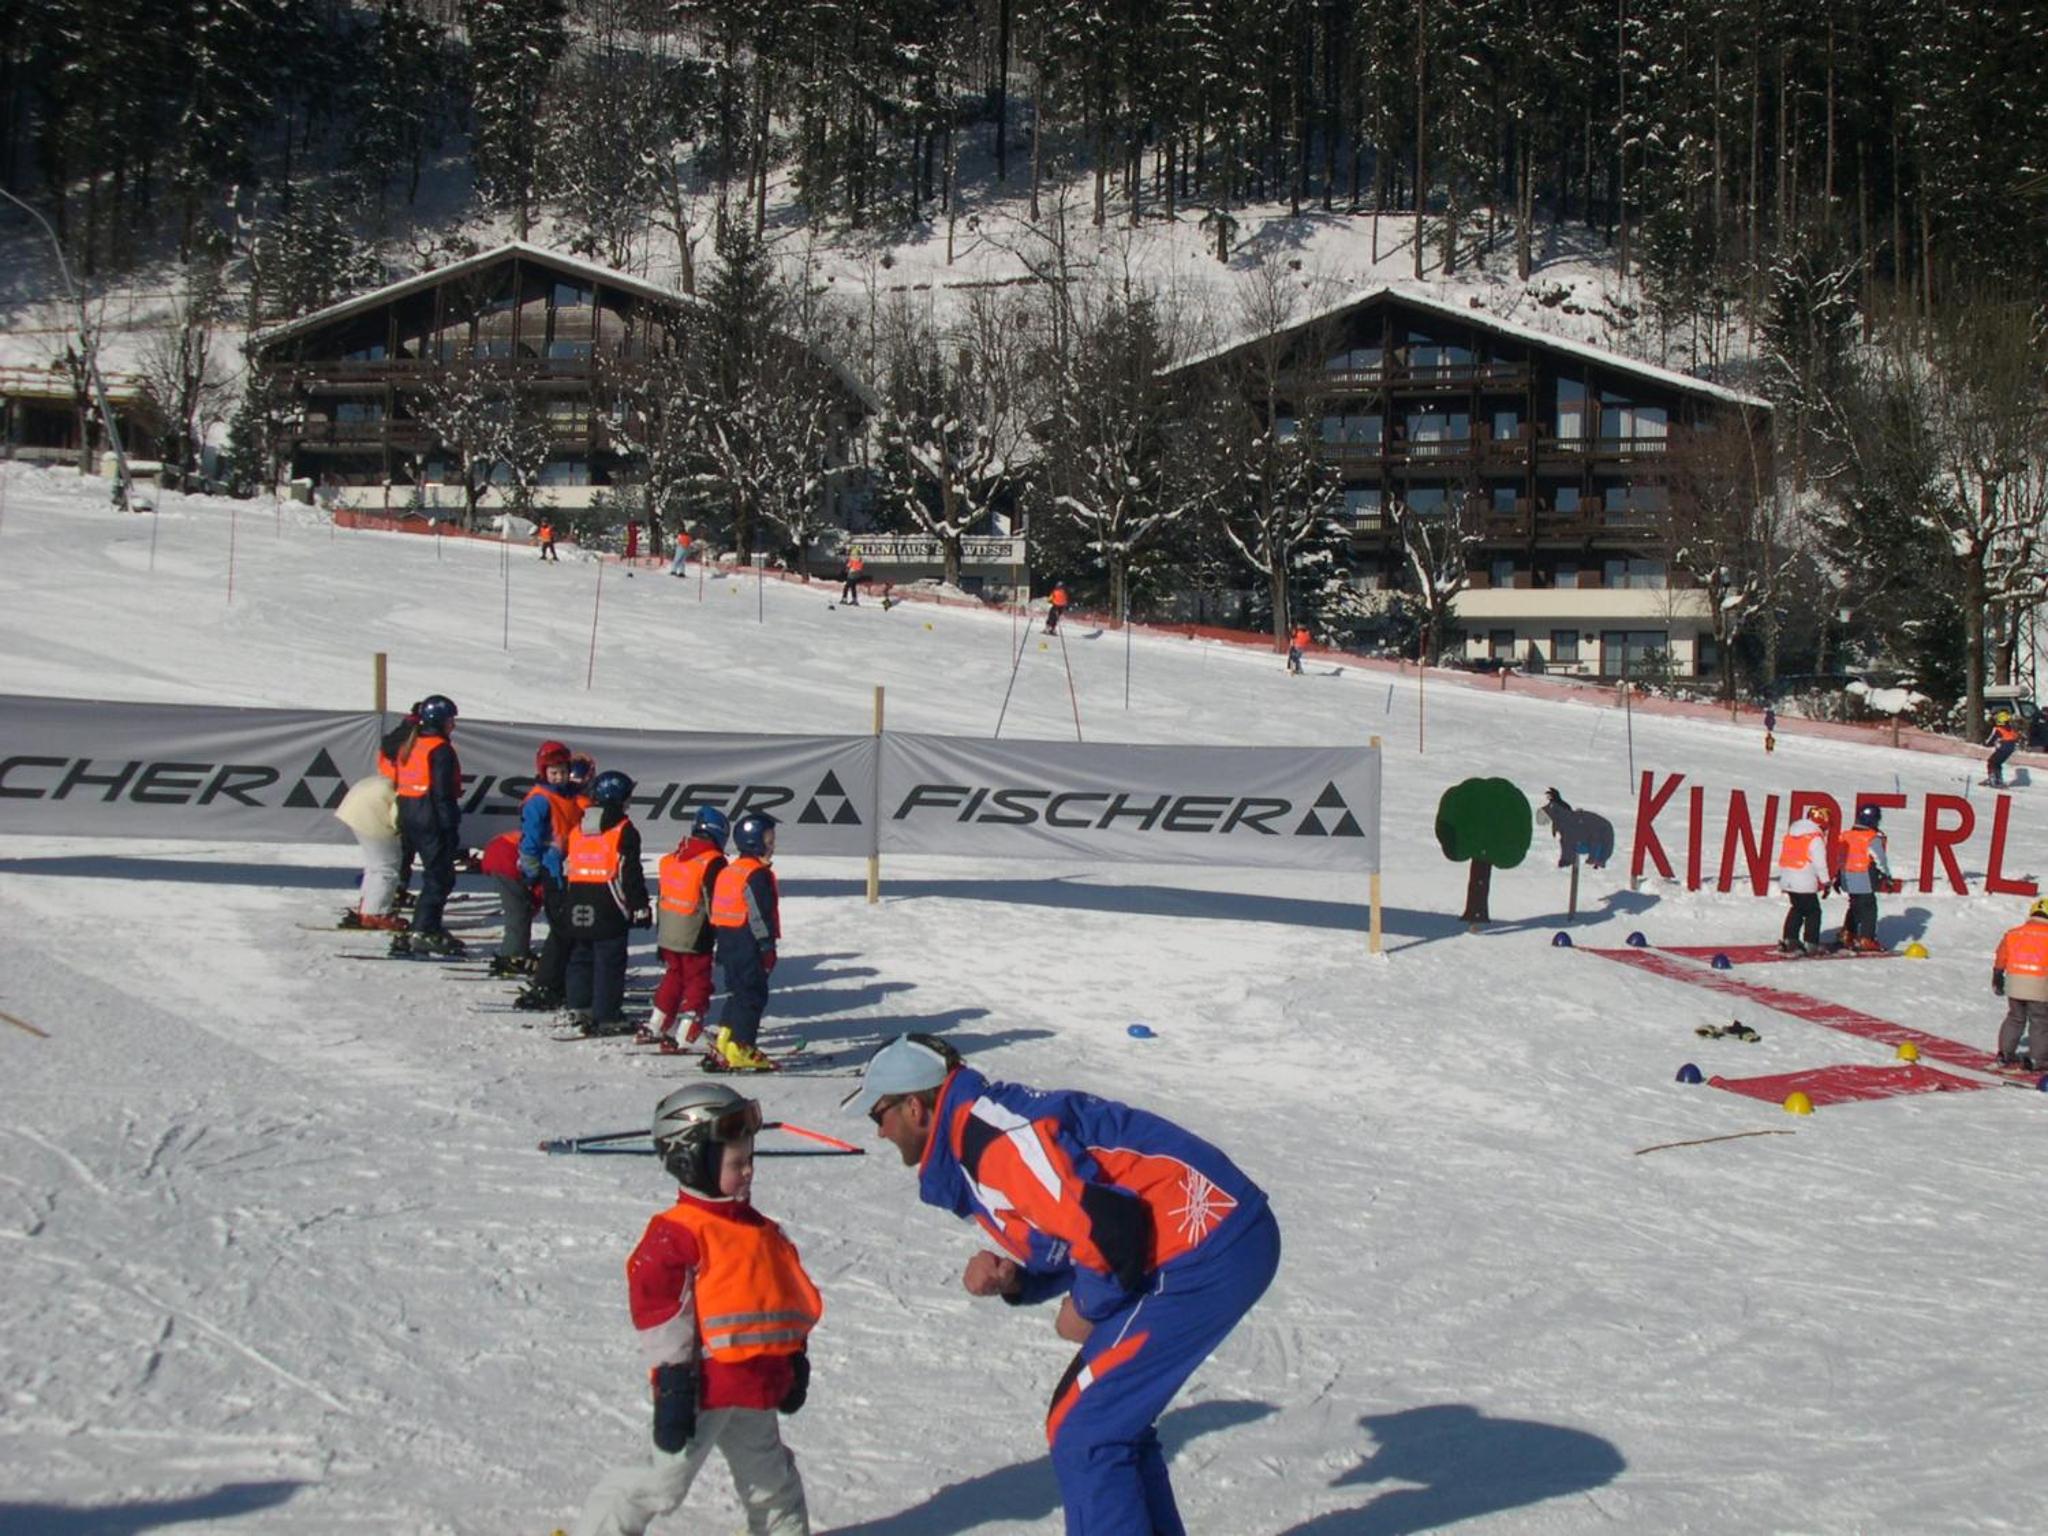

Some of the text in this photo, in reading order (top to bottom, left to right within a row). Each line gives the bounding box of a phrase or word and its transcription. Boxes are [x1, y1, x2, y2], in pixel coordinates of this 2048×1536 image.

[843, 543, 1011, 557] RIENHAUS SWIESE
[459, 774, 795, 824] ISHER
[893, 784, 1292, 835] FISCHER
